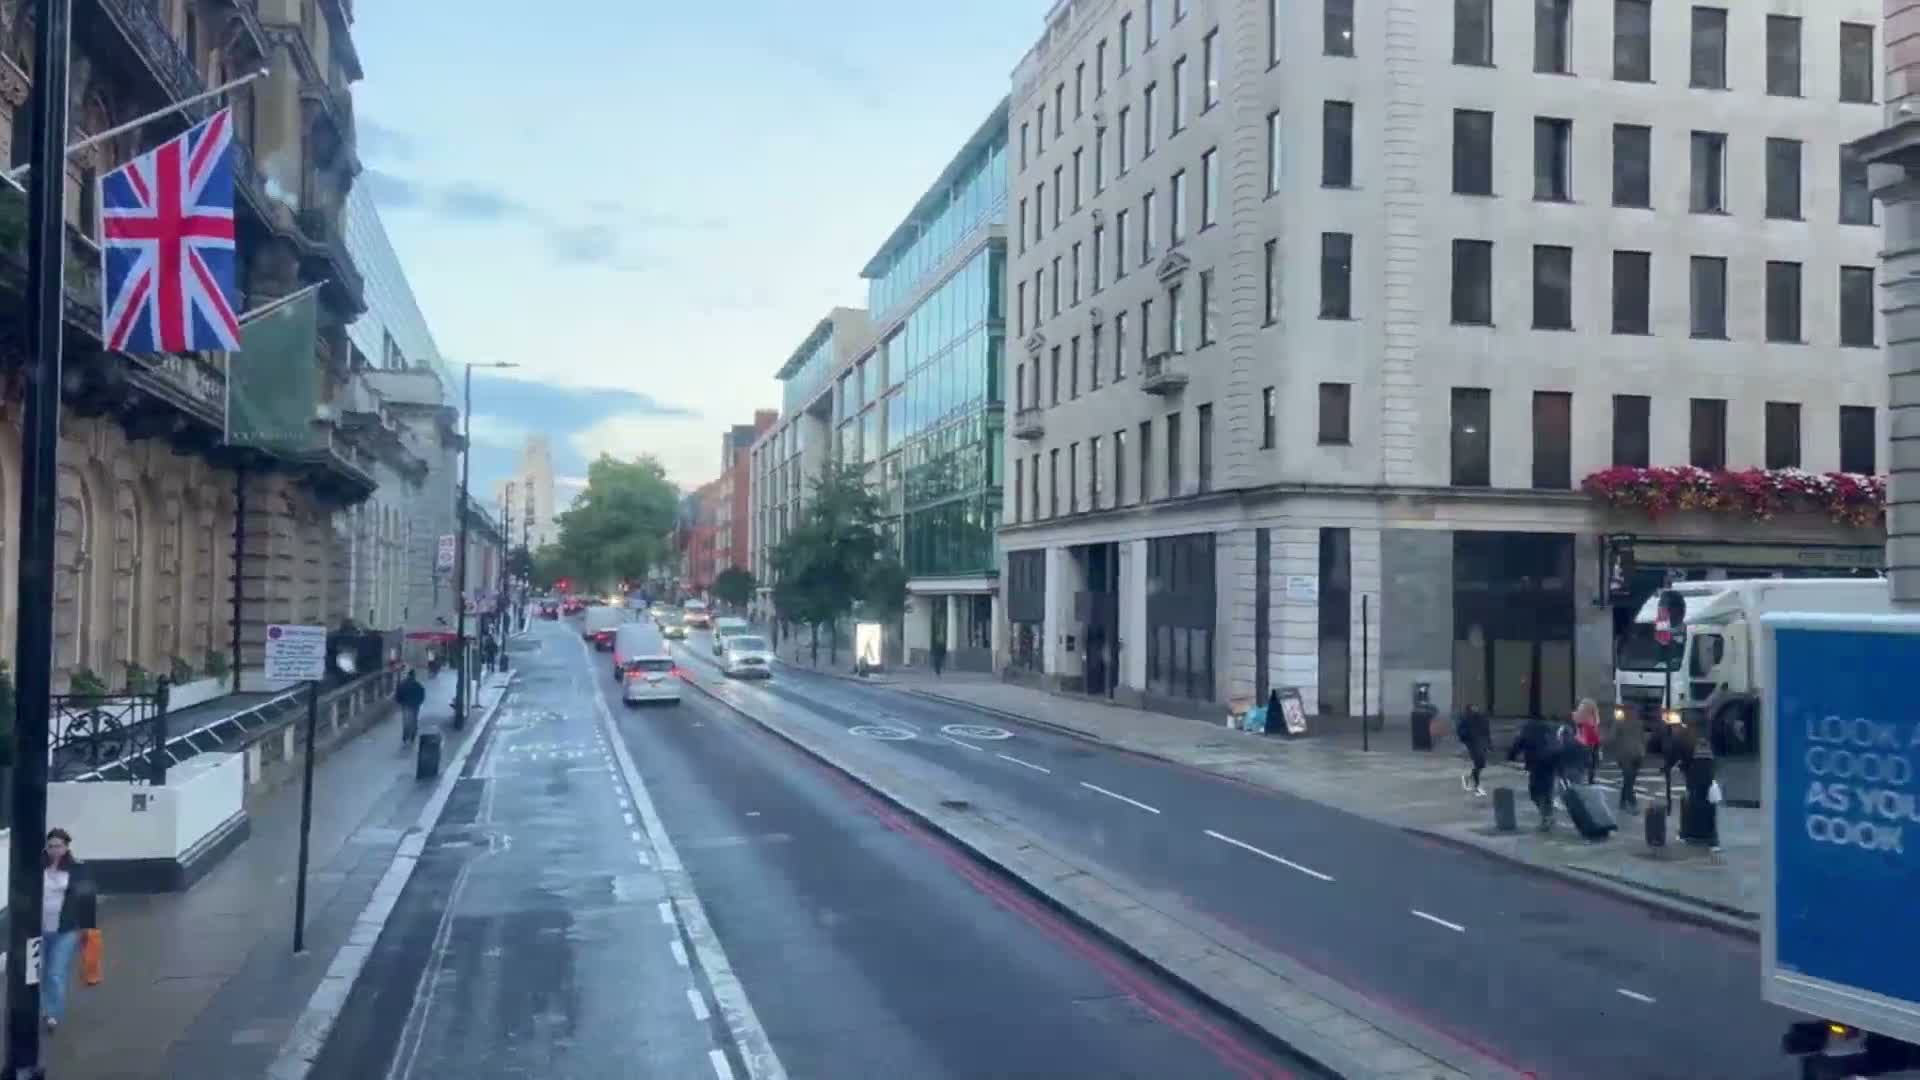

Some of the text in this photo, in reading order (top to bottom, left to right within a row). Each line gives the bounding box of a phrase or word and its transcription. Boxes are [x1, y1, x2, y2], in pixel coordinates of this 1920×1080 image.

[1806, 715, 1901, 749] LOOK
[1806, 746, 1912, 785] GOOD
[1807, 781, 1850, 811] AS
[1806, 815, 1904, 854] COOK
